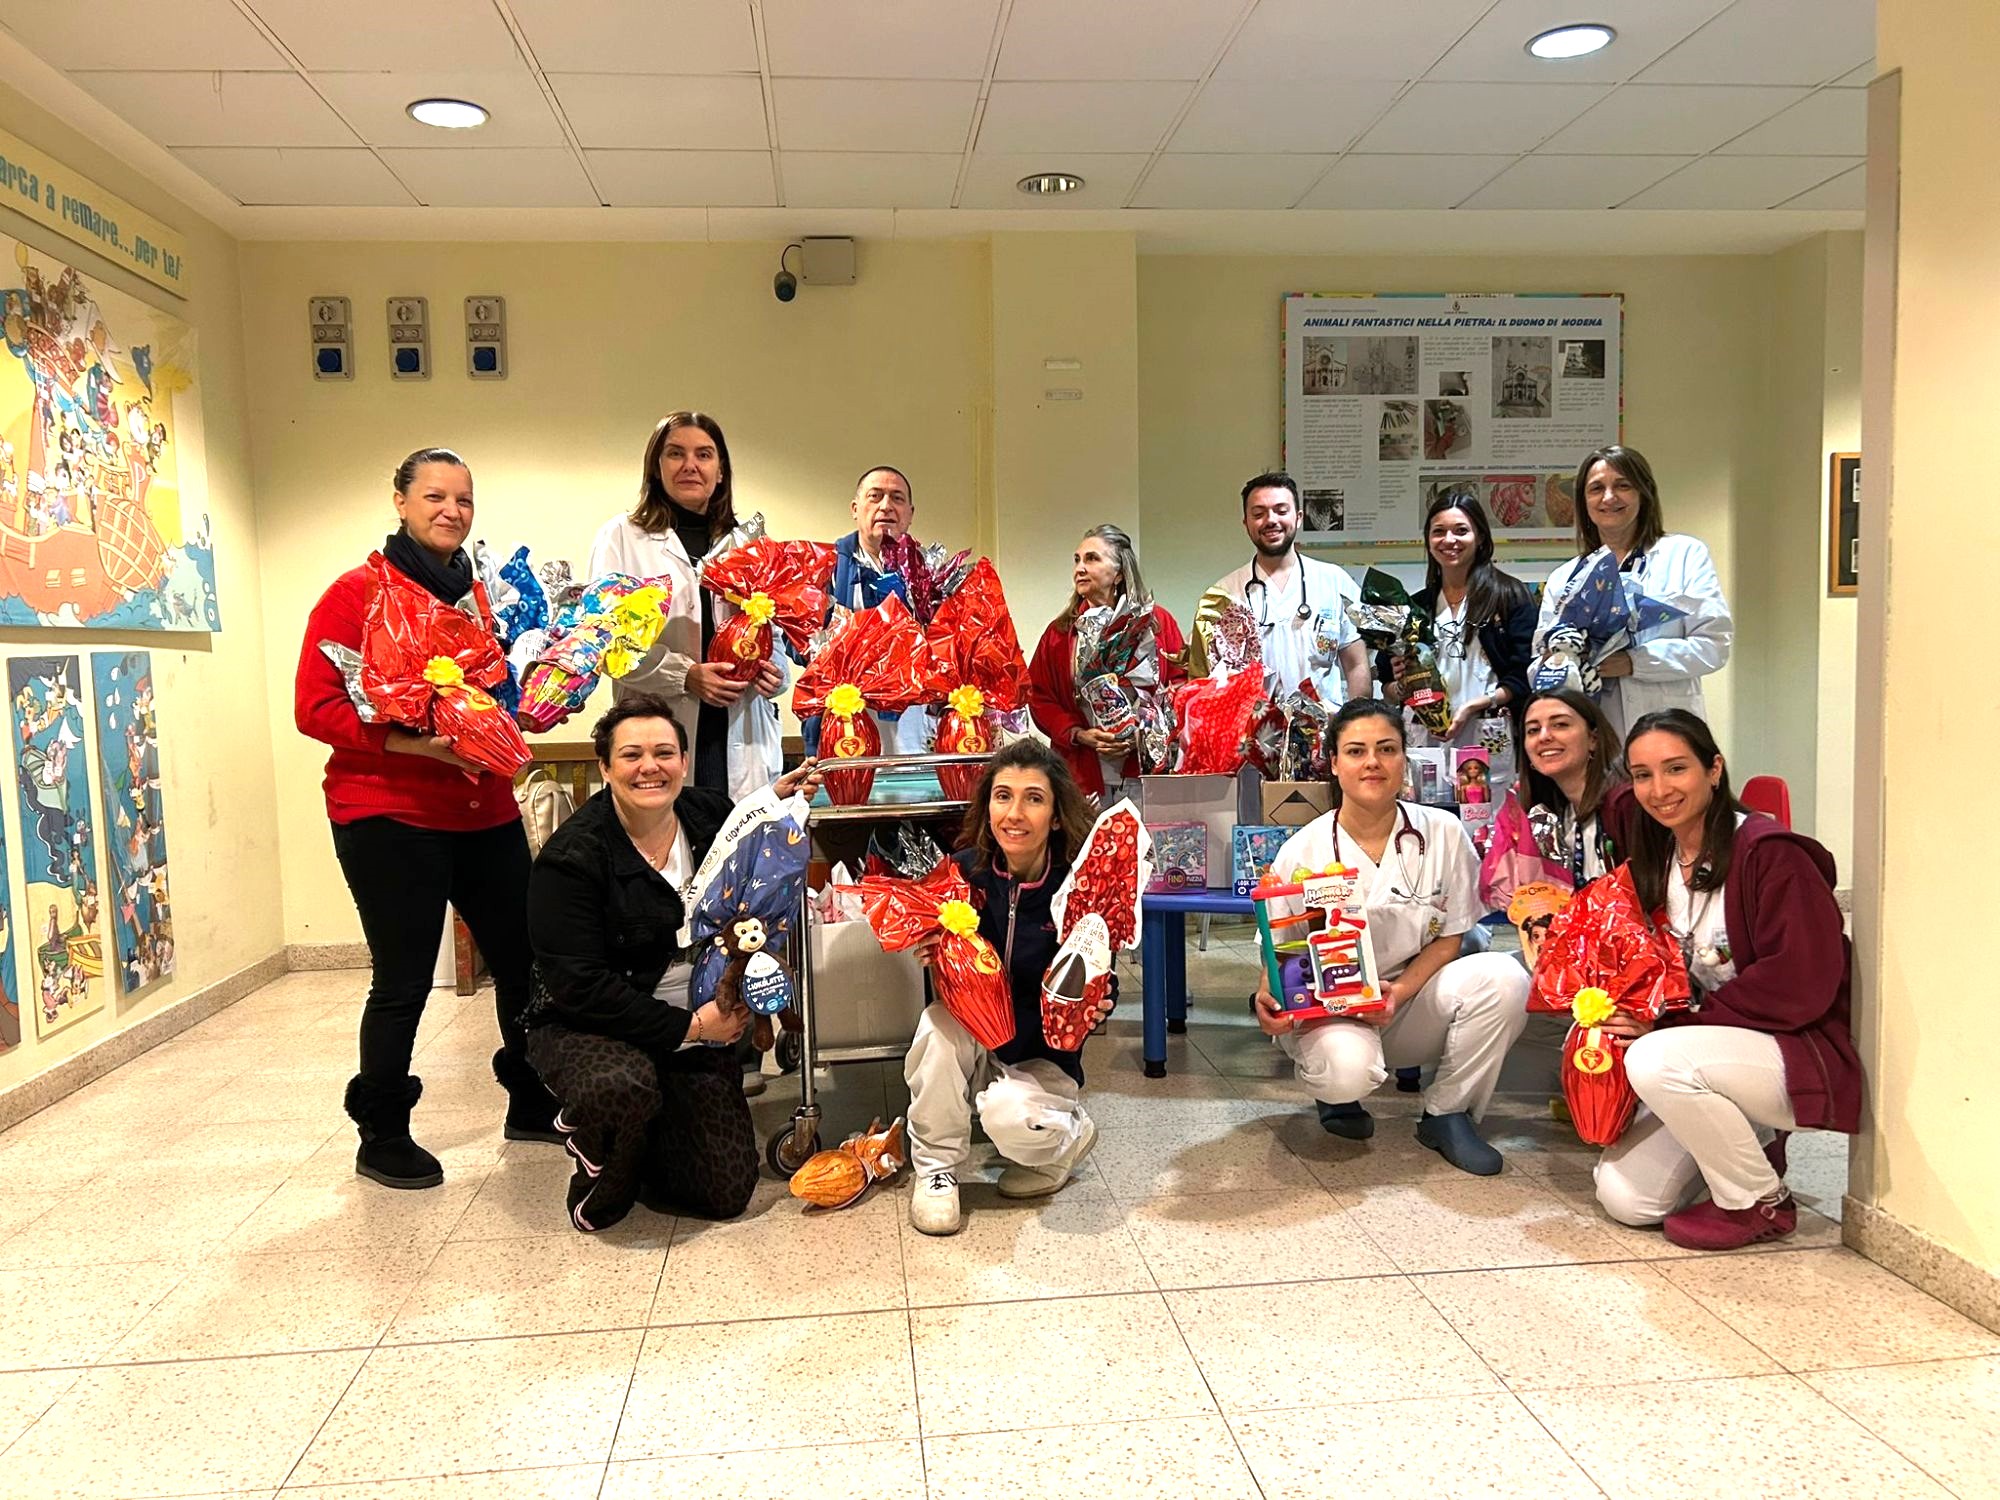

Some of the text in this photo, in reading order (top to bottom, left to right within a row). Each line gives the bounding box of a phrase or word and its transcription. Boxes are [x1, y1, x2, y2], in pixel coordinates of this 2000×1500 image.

[46, 183, 55, 212] a
[1303, 318, 1604, 327] ANIMALI FANTASTICI NELLA PIETRA: IL DUOMO DI MODENA
